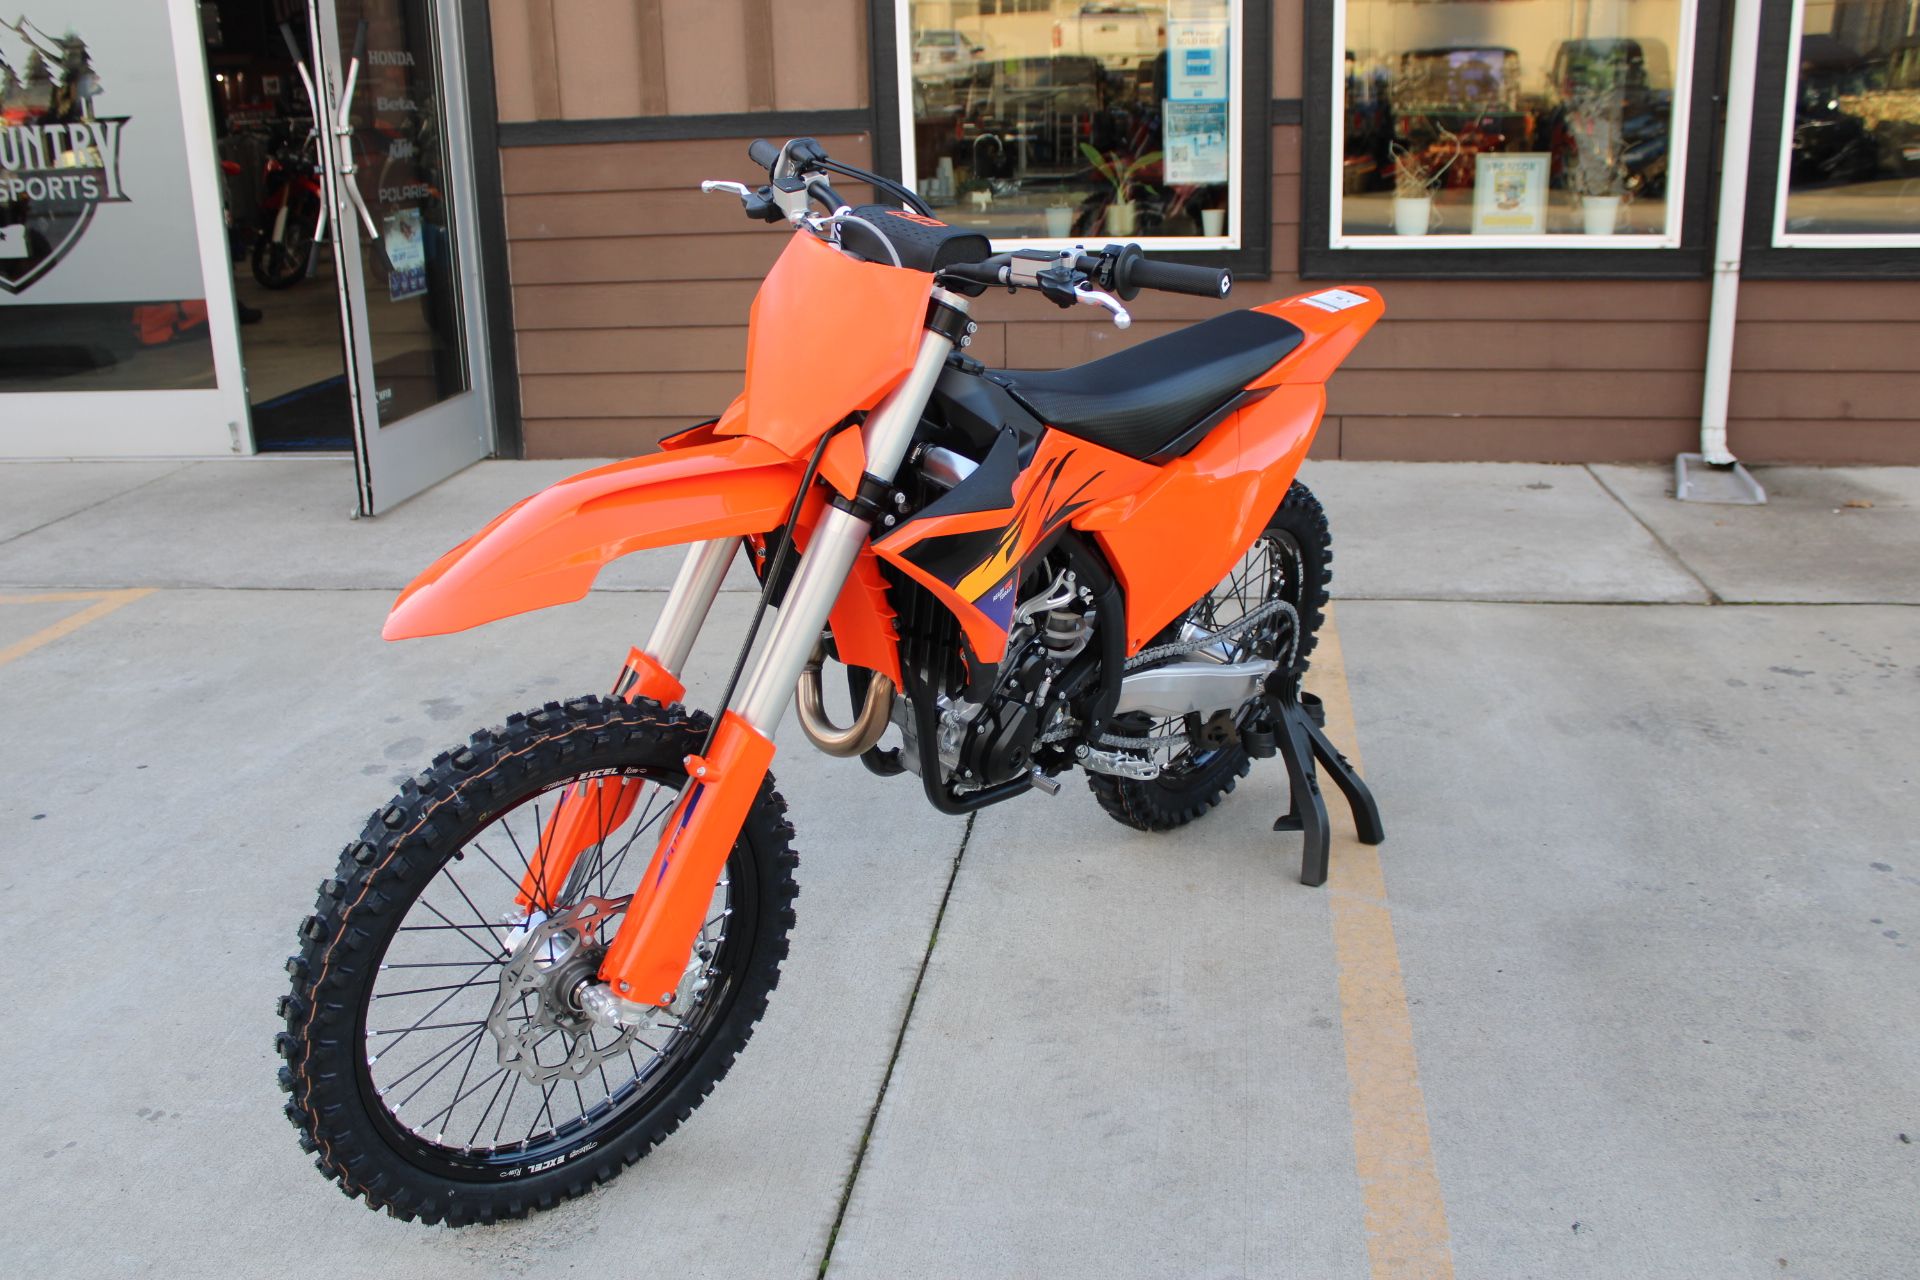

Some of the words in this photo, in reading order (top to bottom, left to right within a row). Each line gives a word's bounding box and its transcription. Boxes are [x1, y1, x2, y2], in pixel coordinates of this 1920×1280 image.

[367, 50, 415, 66] HONDA
[378, 183, 429, 204] POLARIS
[578, 767, 619, 780] EXCEL
[528, 1155, 566, 1173] EXCEL
